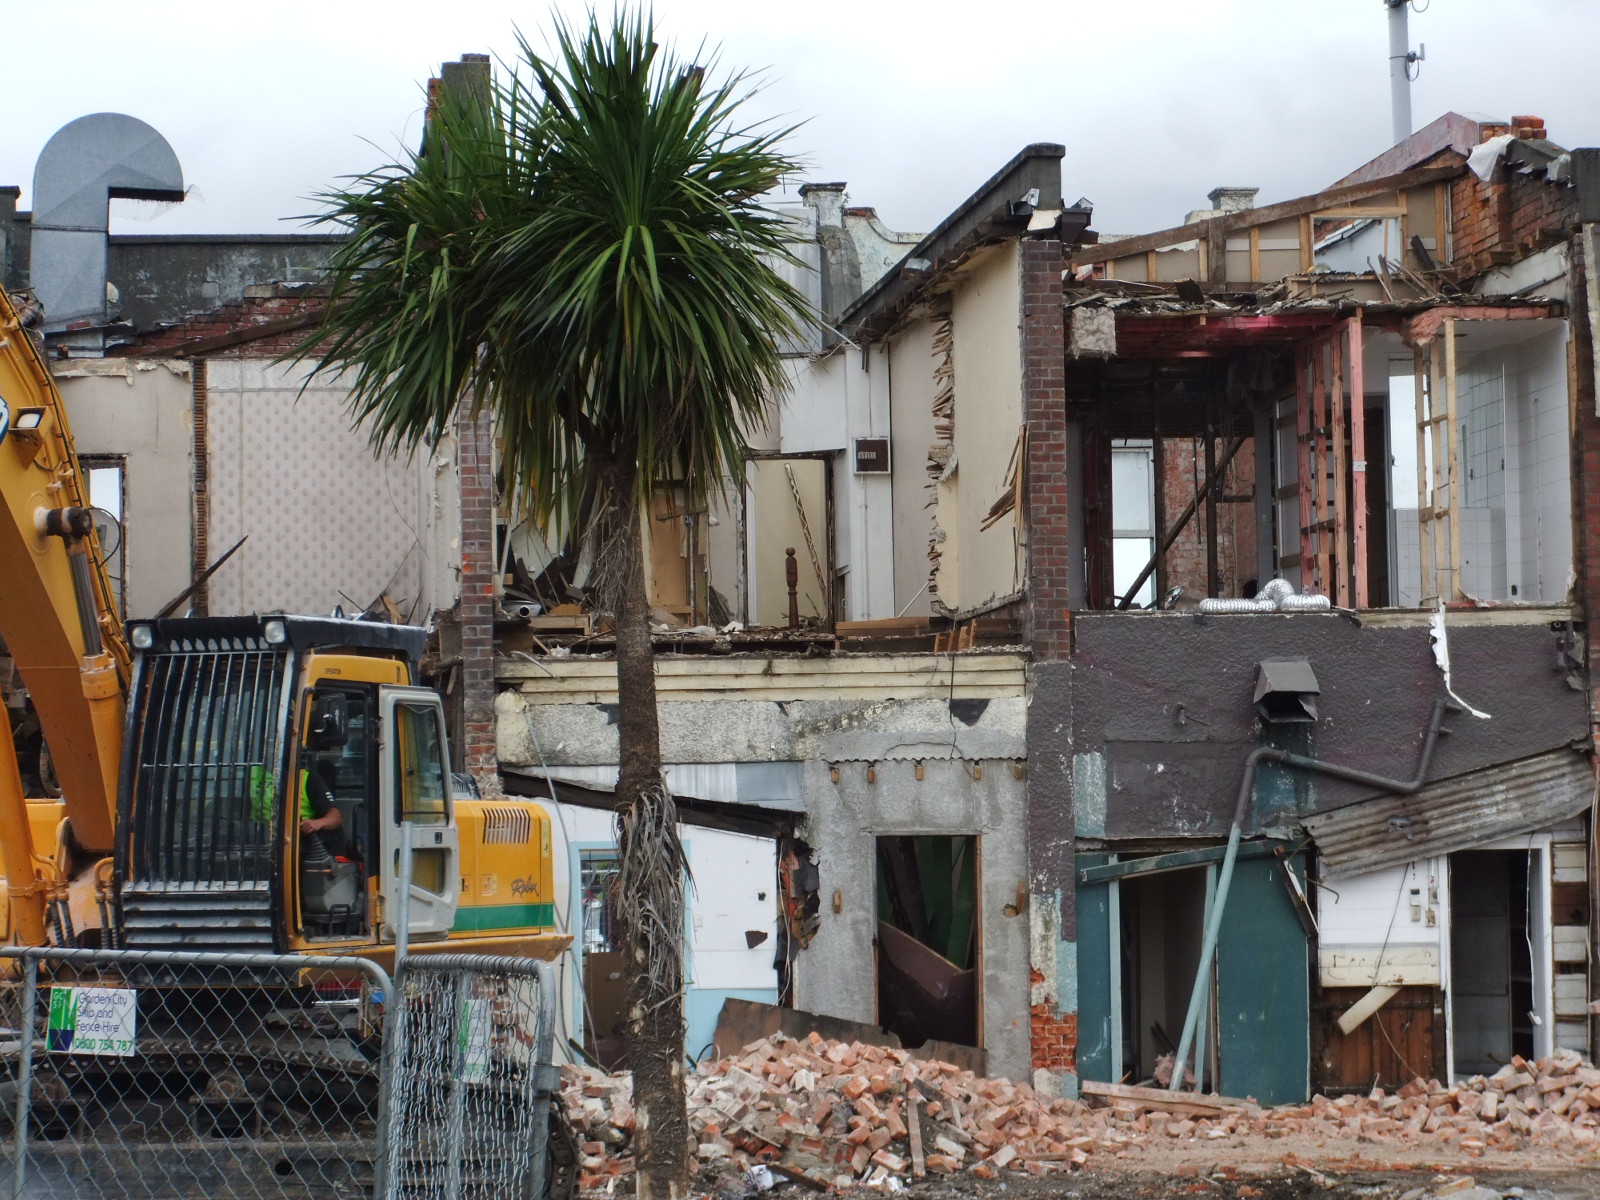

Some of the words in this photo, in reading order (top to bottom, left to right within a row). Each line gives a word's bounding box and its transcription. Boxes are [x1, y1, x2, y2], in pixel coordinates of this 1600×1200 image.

[79, 992, 110, 1004] Garden
[113, 993, 127, 1007] City
[77, 1007, 95, 1020] Skip
[97, 1008, 114, 1019] and
[76, 1020, 100, 1032] Fence
[103, 1021, 120, 1033] Hire
[75, 1039, 95, 1050] 0800
[117, 1040, 133, 1051] 787
